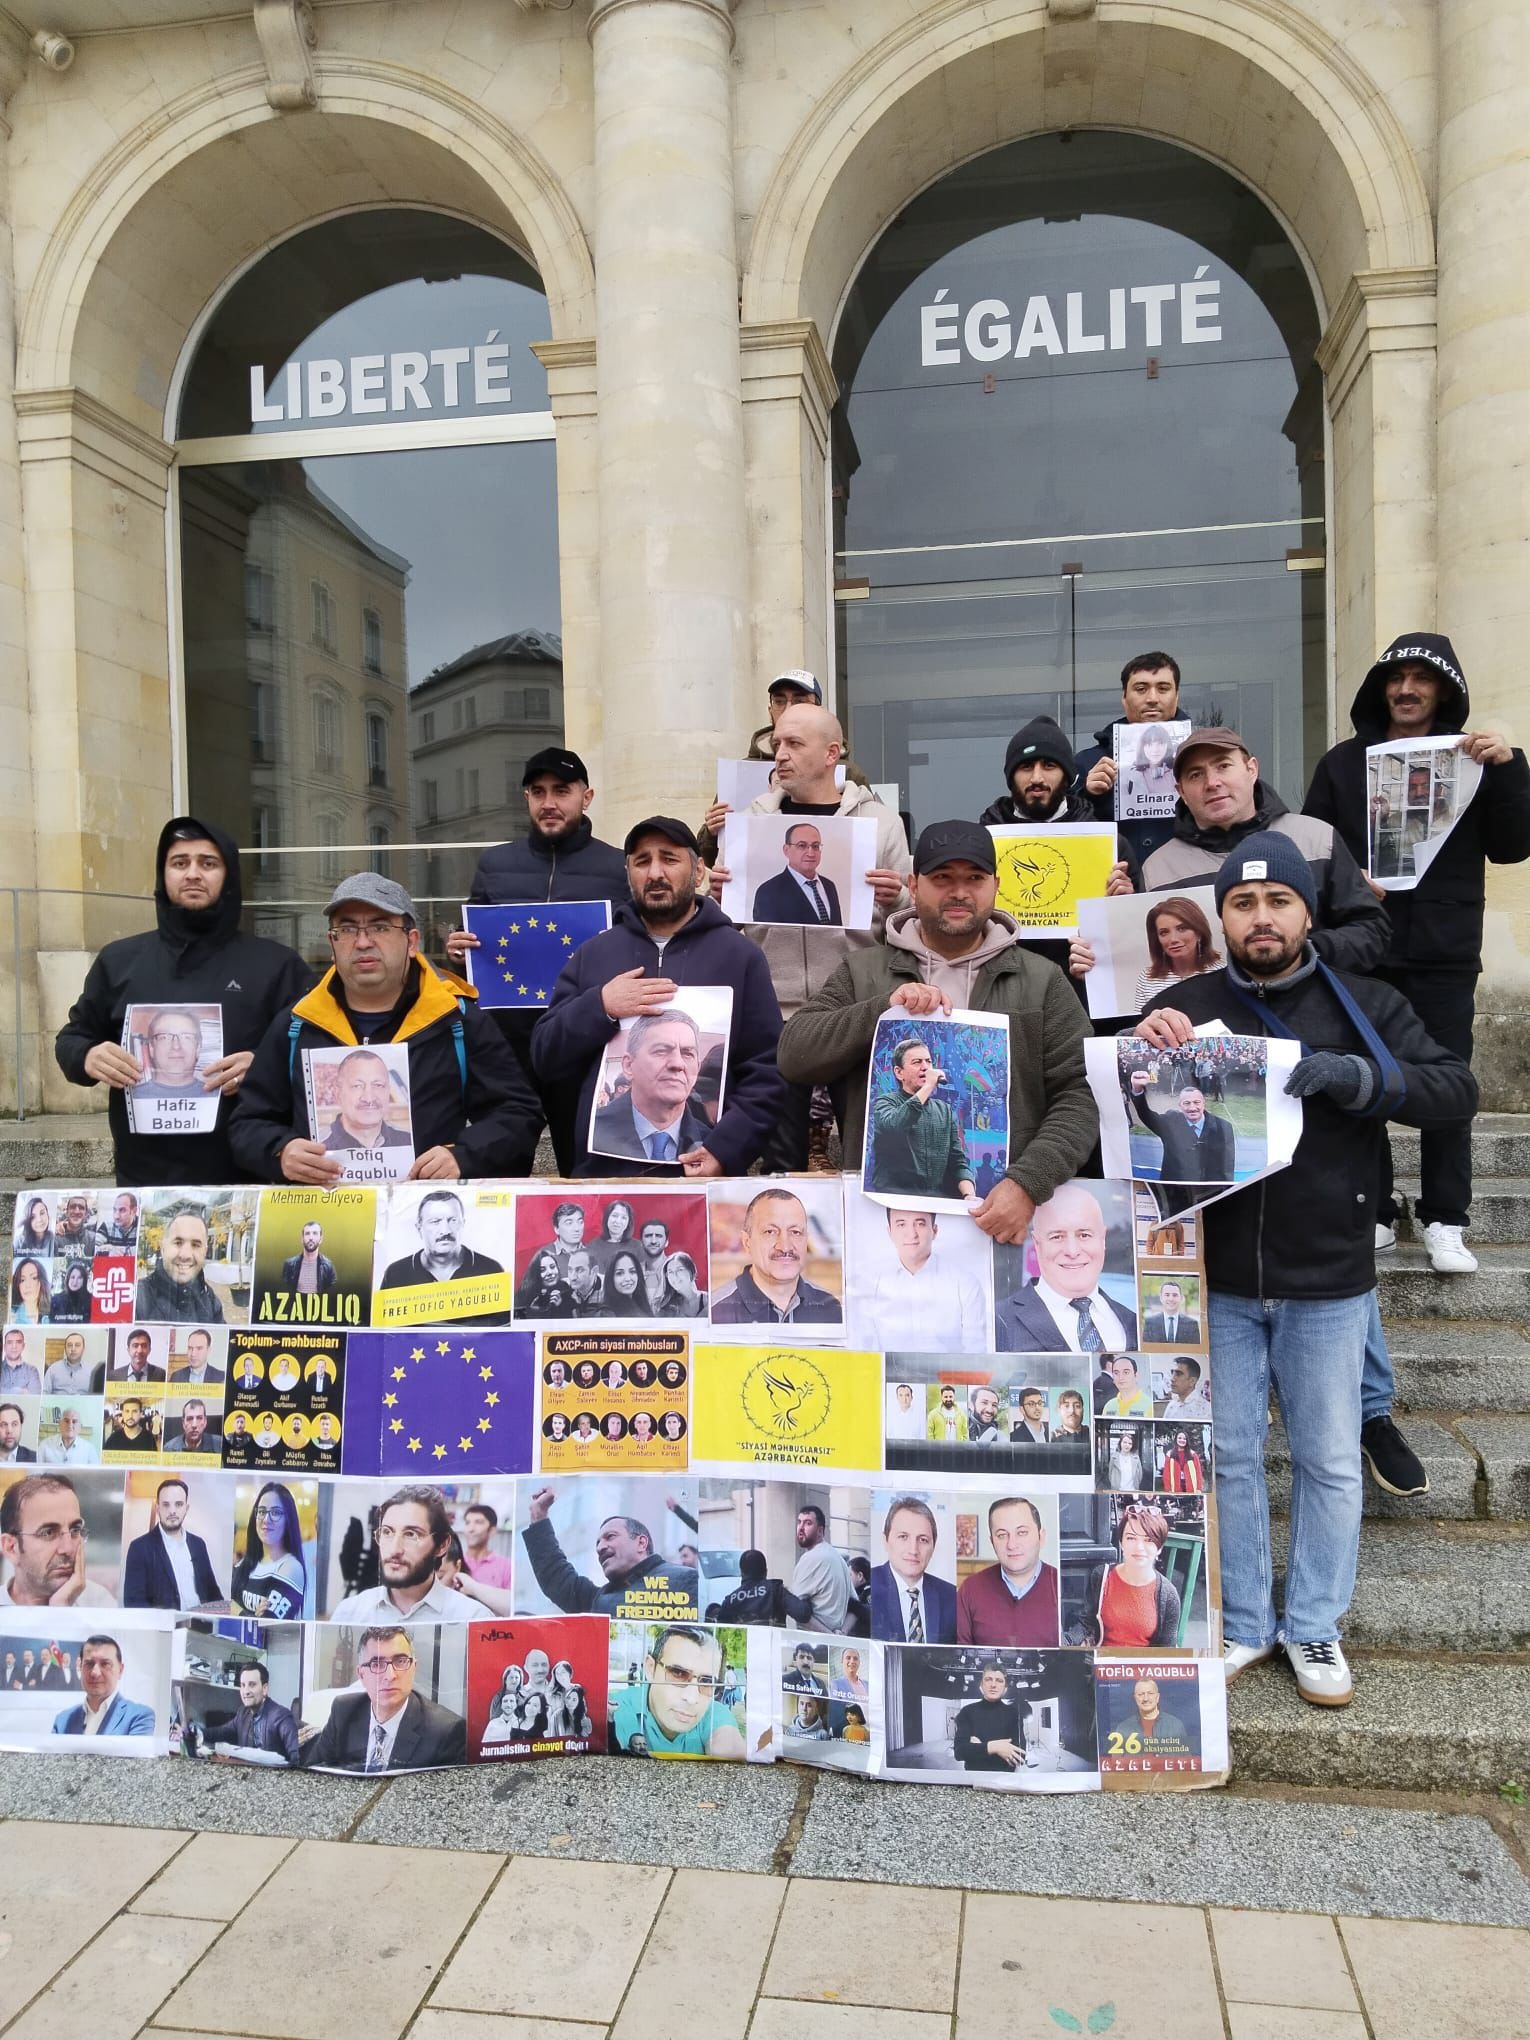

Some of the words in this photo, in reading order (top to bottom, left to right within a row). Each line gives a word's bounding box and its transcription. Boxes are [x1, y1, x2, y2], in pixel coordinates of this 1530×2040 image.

[920, 265, 1222, 366] ÉGALITÉ
[250, 329, 511, 422] LIBERTÉ
[1136, 794, 1175, 804] Elnara
[156, 1099, 197, 1112] Hafiz
[151, 1117, 200, 1130] Babalı
[346, 1149, 384, 1163] Tofiq
[270, 1191, 317, 1204] Mehman
[259, 1291, 362, 1326] AZADLIQ
[383, 1305, 408, 1318] FREE
[413, 1300, 445, 1313] TOFIG
[450, 1291, 501, 1309] YAGUBLU
[281, 1334, 340, 1349] məhbusları
[555, 1340, 598, 1351] AXCP-nin
[600, 1340, 626, 1352] siyasi
[627, 1338, 678, 1351] məhbusları
[754, 1452, 818, 1464] AZƏRBAYCAN
[643, 1576, 669, 1590] WE
[624, 1590, 690, 1605] DEMAND
[616, 1605, 698, 1620] FREEDOOM
[1098, 1665, 1134, 1678] TOFİQ
[1138, 1667, 1195, 1678] YAQUBLU
[480, 1743, 531, 1757] Jurnalistika
[1107, 1731, 1142, 1755] 26
[1143, 1737, 1159, 1745] gün
